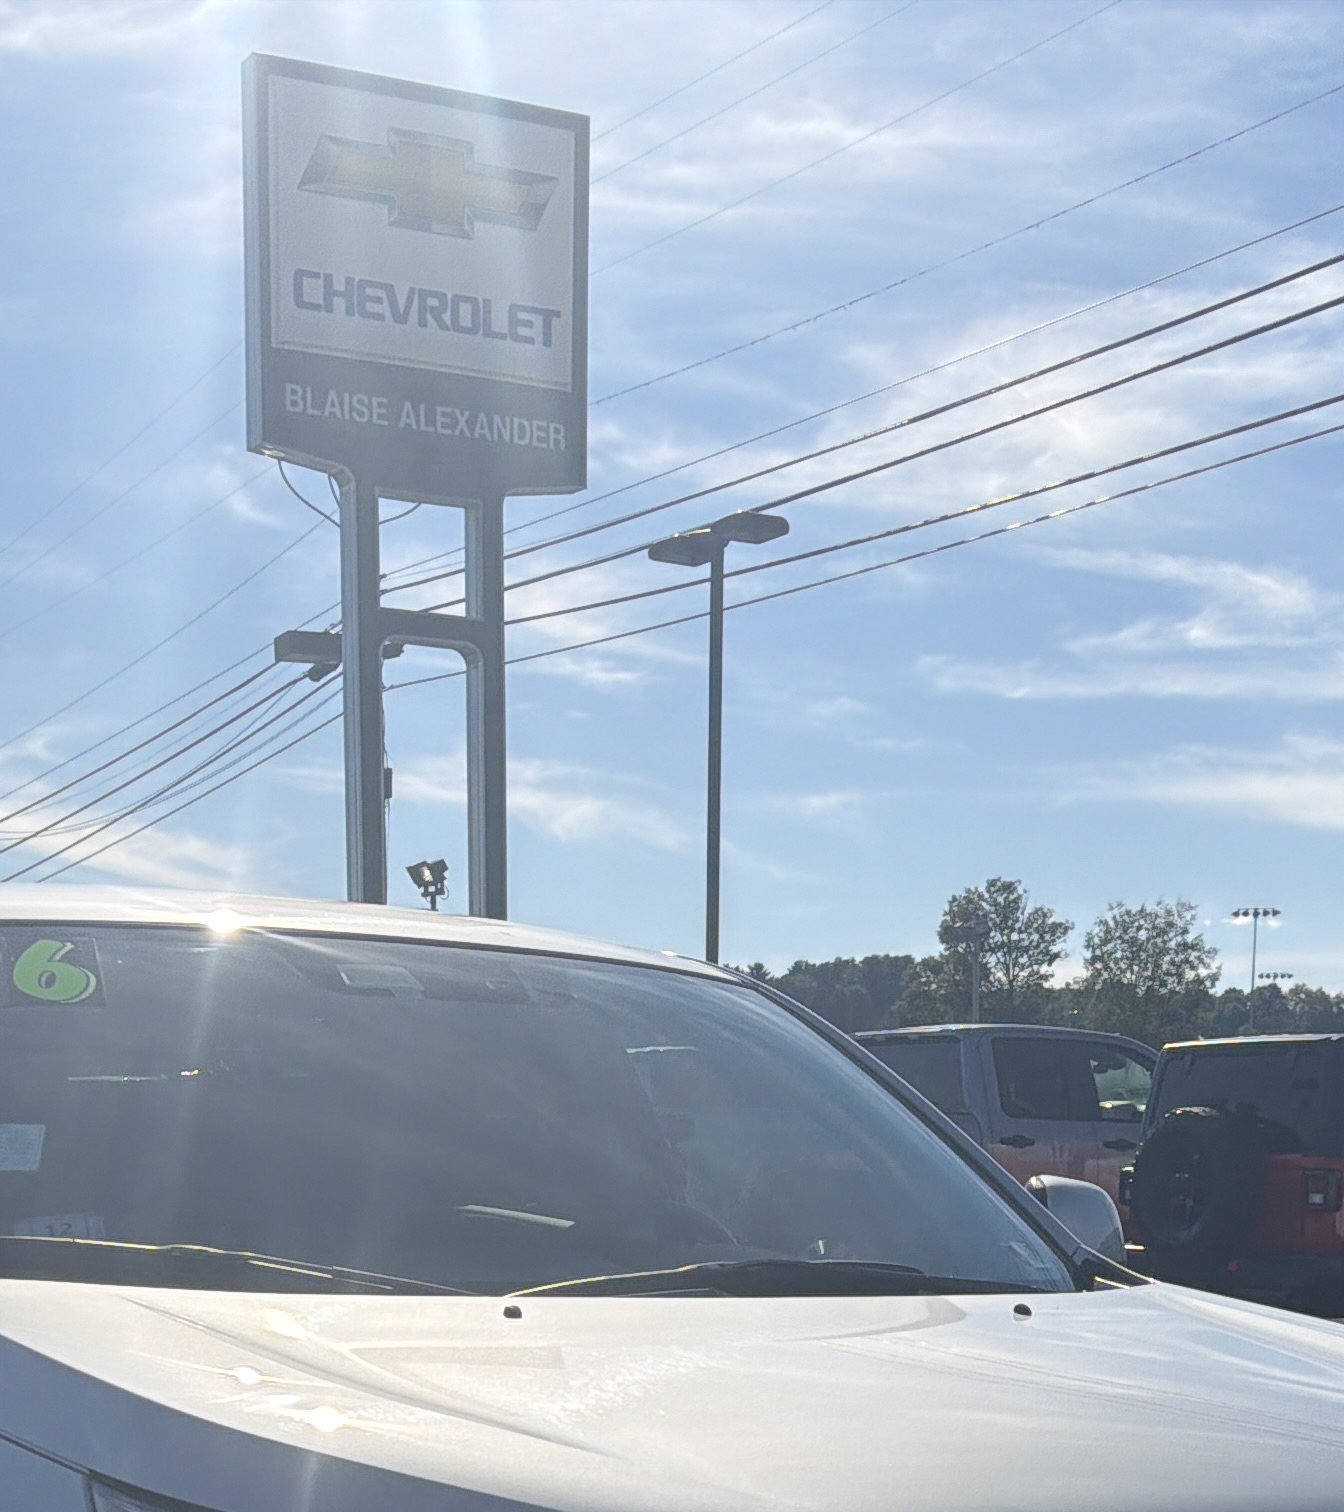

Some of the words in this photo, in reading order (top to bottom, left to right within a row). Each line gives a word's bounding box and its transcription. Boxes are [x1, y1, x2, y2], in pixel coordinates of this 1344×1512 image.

[292, 268, 562, 349] CHEVROLET
[284, 382, 389, 427] BLAISE
[398, 400, 567, 452] ALEXANDER
